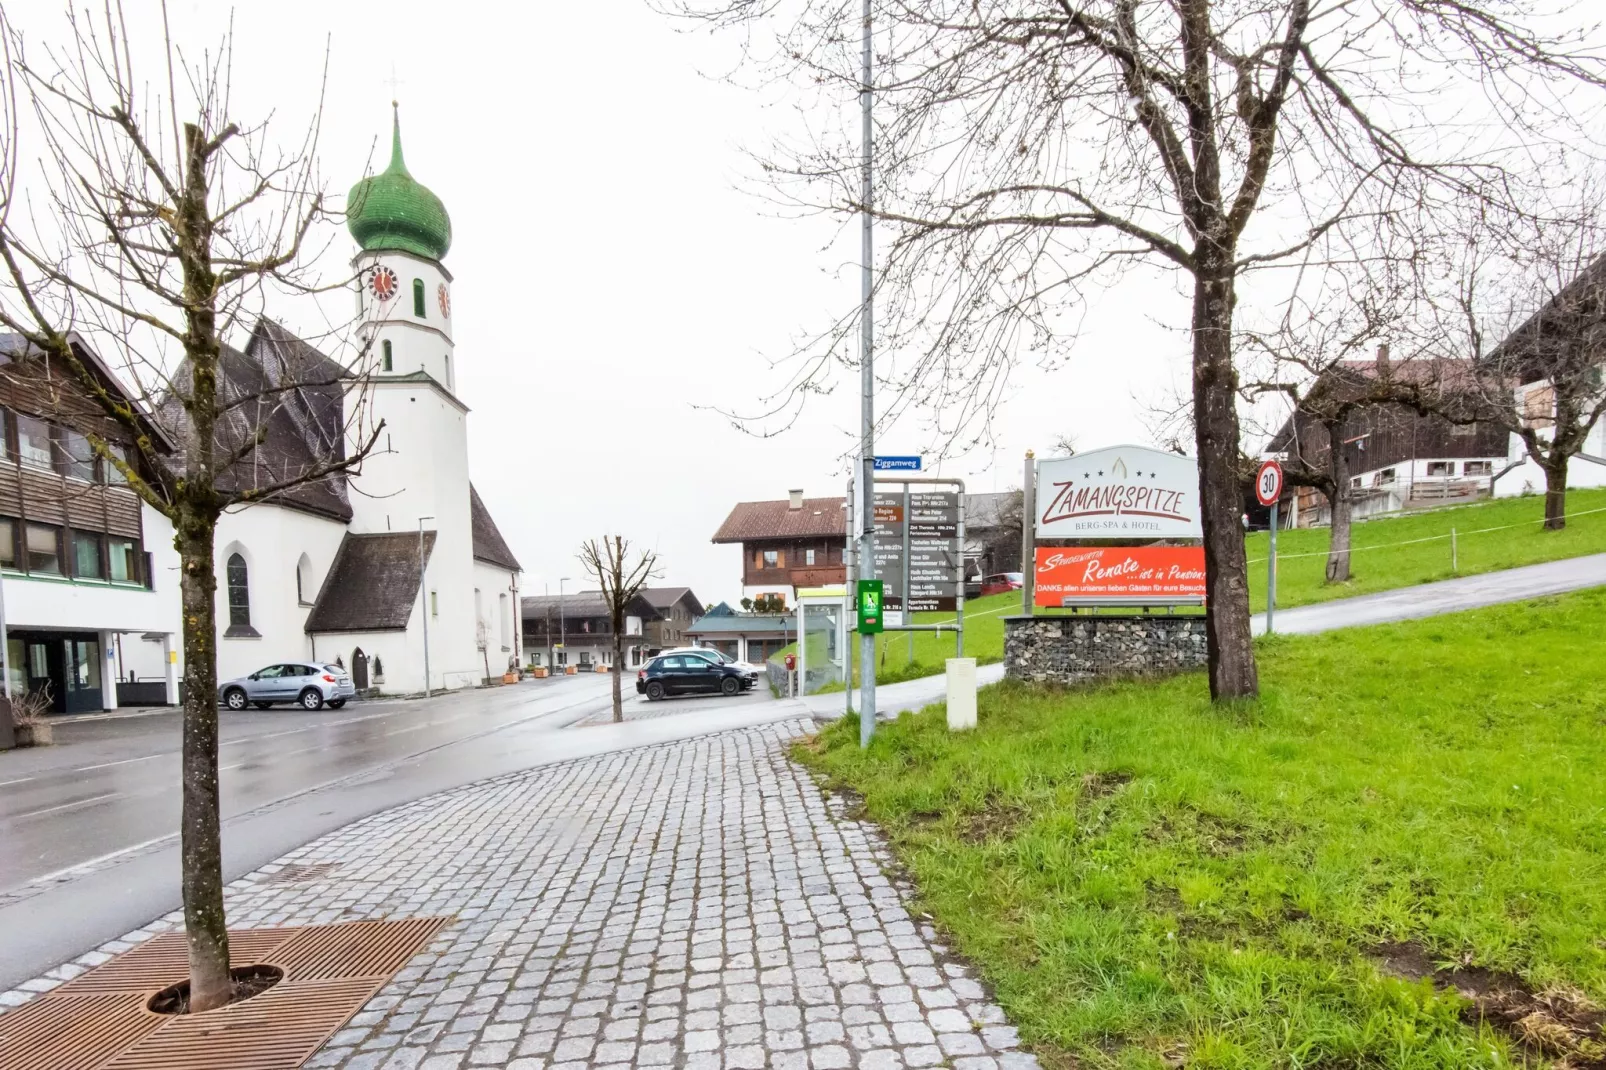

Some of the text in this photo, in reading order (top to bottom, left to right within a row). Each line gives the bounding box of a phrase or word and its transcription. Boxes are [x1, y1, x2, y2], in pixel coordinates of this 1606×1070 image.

[875, 459, 916, 468] Ziggamweg
[1263, 473, 1274, 493] 30
[1042, 481, 1191, 524] ZAMANGSPITZE
[1075, 520, 1161, 531] BERG-SPA & HOTEL
[1082, 556, 1139, 583] Renate
[1155, 568, 1164, 580] in
[1037, 584, 1062, 592] DANKE
[1064, 584, 1079, 592] allen
[1108, 584, 1127, 592] lieben
[1129, 584, 1152, 592] Gästen
